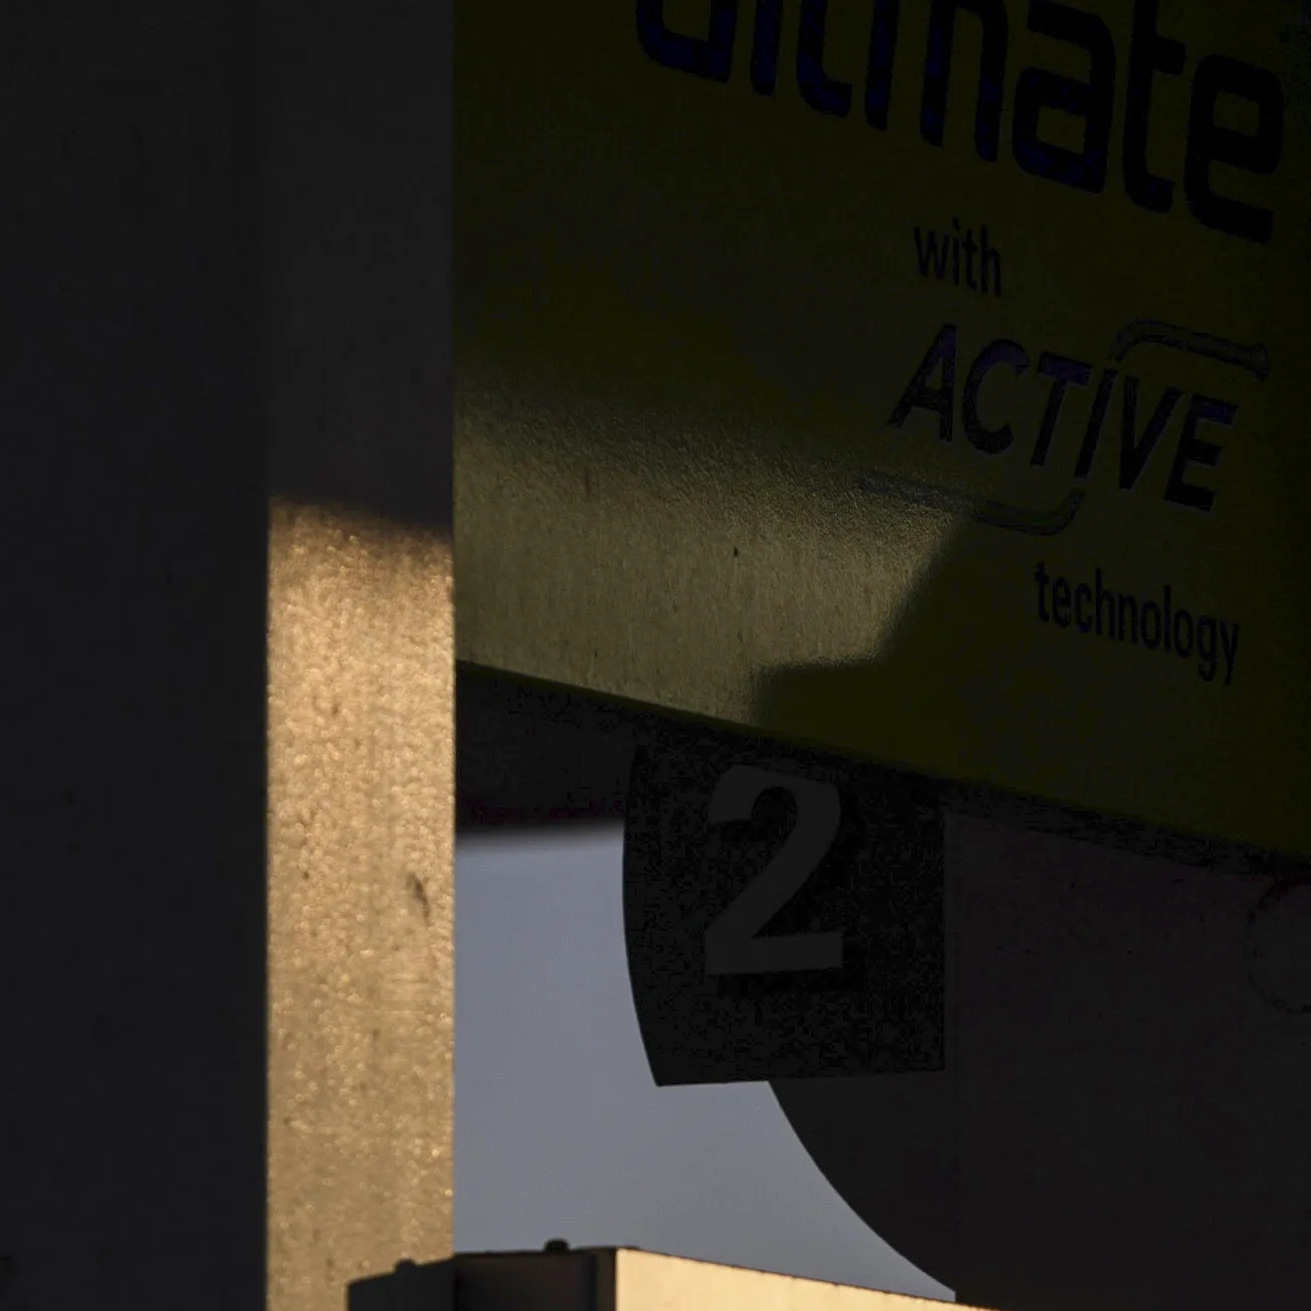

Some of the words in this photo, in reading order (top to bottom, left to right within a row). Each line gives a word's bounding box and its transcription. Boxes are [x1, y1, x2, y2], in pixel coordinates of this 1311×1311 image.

[914, 217, 1001, 297] with
[889, 323, 1240, 511] ACTIVE
[1035, 561, 1239, 685] technology
[704, 763, 843, 975] 2
